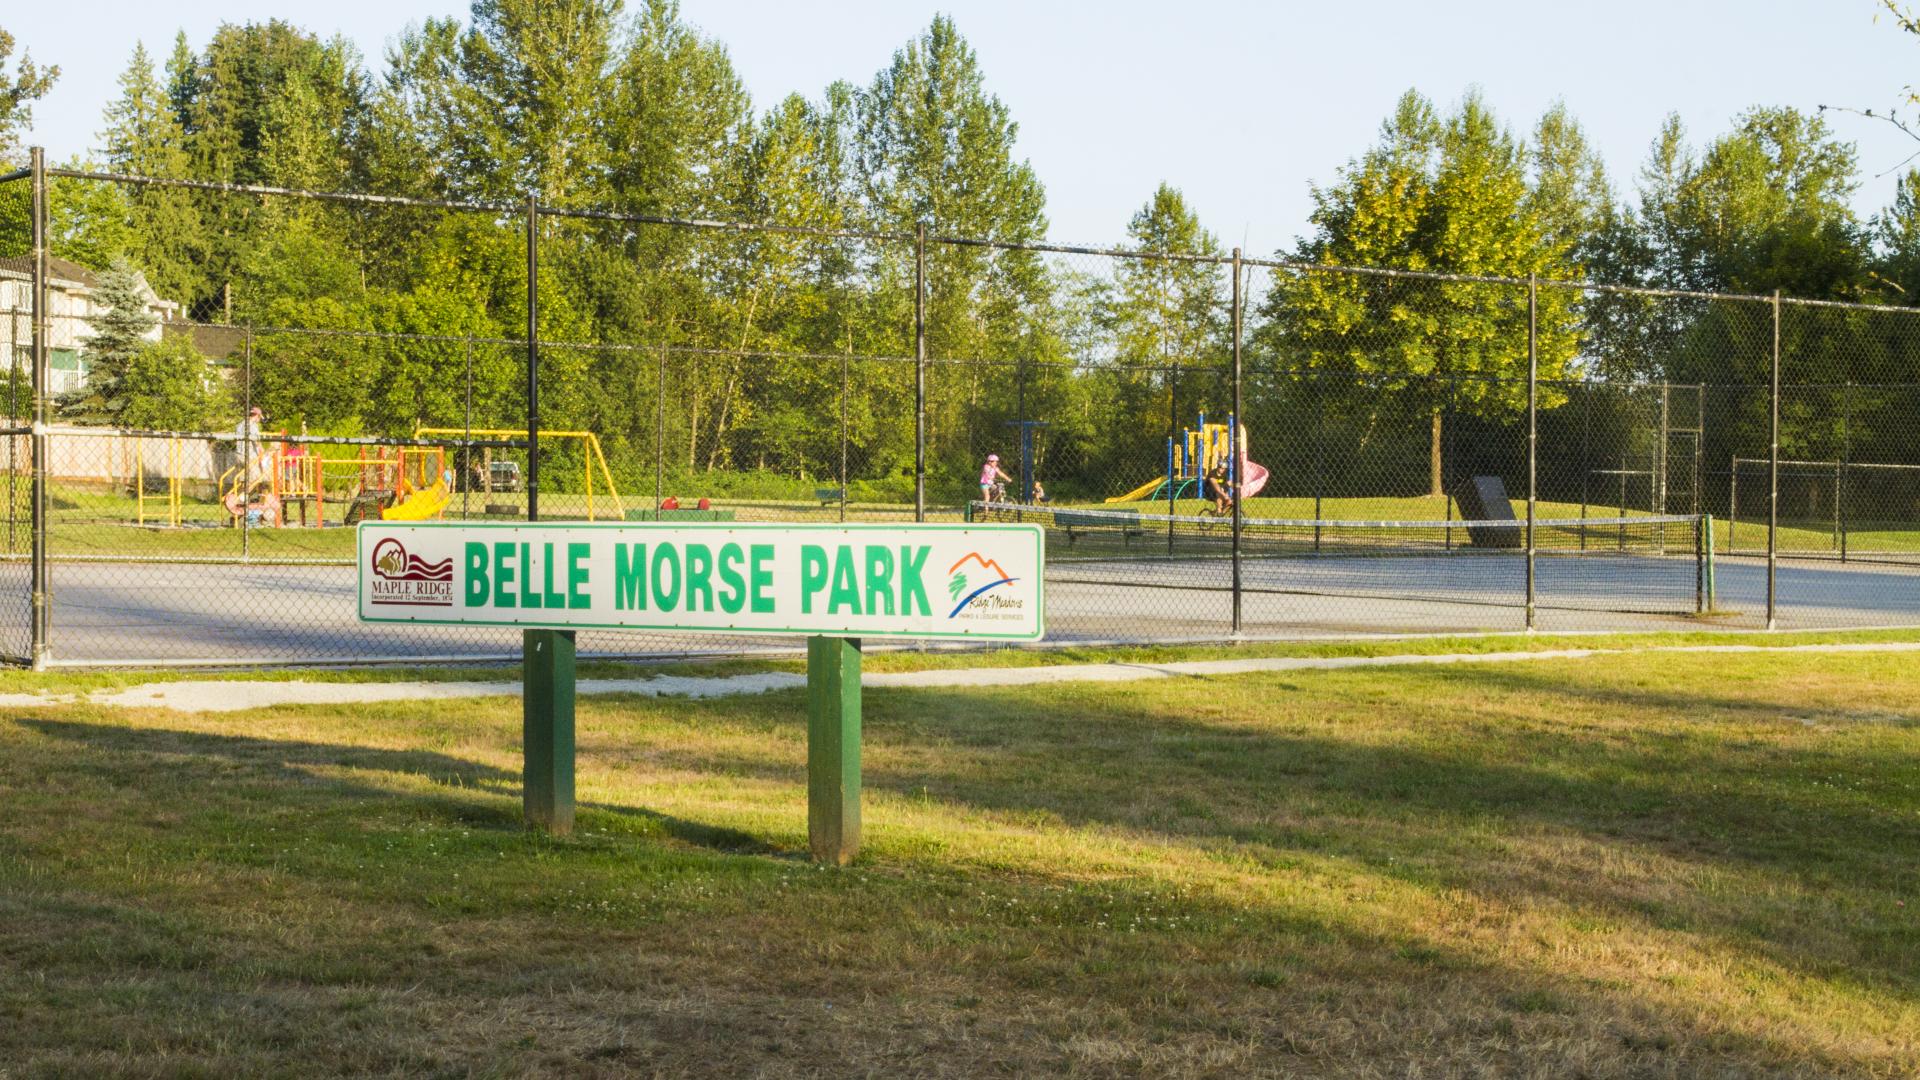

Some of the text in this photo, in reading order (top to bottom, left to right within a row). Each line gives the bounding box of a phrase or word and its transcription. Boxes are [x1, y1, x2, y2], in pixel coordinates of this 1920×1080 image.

[372, 581, 453, 595] MAPLE RIDGE
[464, 541, 933, 616] BELLE MORSE PARK
